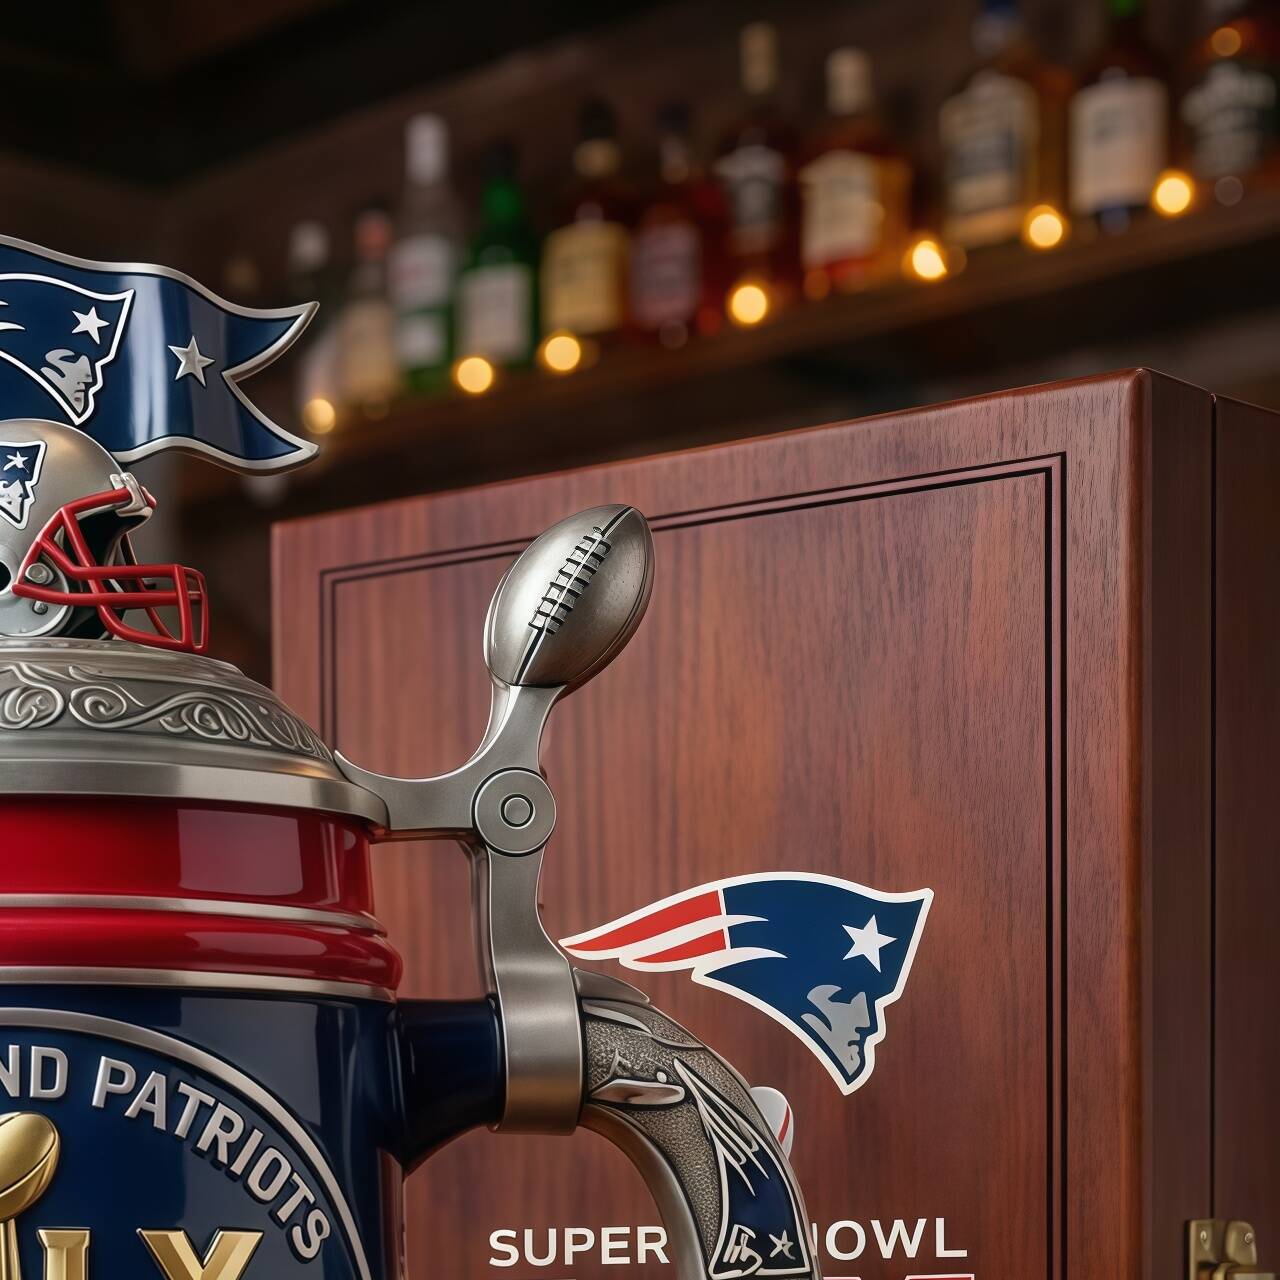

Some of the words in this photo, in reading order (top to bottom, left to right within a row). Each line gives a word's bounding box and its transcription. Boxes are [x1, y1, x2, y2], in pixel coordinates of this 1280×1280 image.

[92, 1056, 332, 1262] PATRIOTS
[488, 1226, 671, 1267] SUPER
[810, 1217, 968, 1261] OWL
